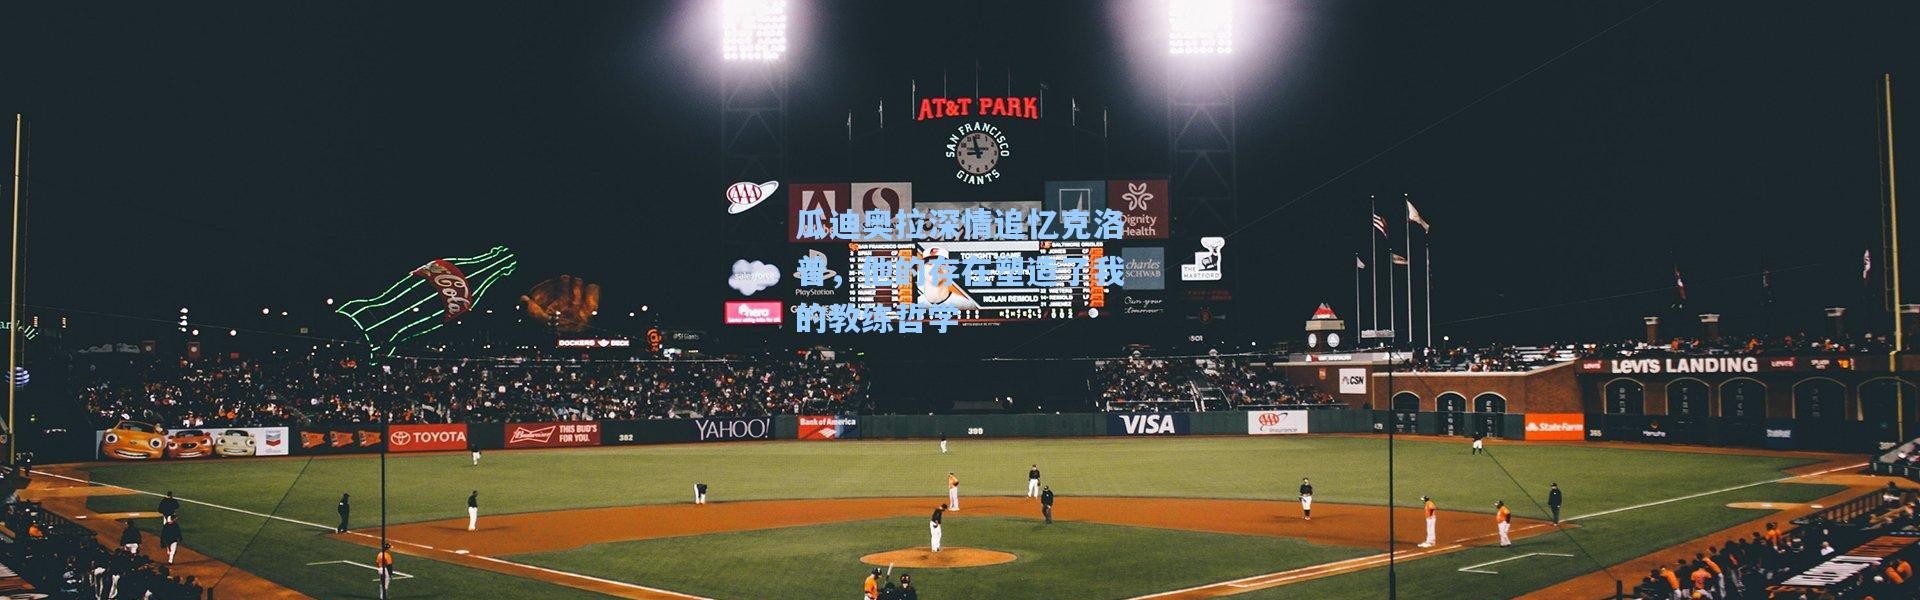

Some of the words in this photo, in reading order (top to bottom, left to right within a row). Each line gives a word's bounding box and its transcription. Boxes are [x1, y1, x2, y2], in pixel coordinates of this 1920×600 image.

[918, 97, 972, 120] AT&T
[979, 97, 1038, 119] PARK
[946, 134, 960, 158] SAN
[958, 121, 1010, 157] FRANCISCO
[956, 169, 1000, 185] GIANTS
[1120, 215, 1156, 226] Dignity
[1125, 258, 1160, 270] charles
[1125, 270, 1161, 278] SCHWAB
[434, 274, 471, 316] Cola
[795, 288, 835, 298] PlayStation
[1666, 357, 1759, 373] LANDING
[1350, 376, 1364, 385] CSN
[800, 418, 818, 426] Bank
[827, 418, 856, 426] America
[1119, 415, 1176, 435] VISA
[559, 425, 575, 433] THIS
[577, 424, 598, 432] BUD'S
[695, 418, 770, 441] YAHOO!
[413, 431, 467, 443] TOYOTA
[559, 434, 573, 442] FOR
